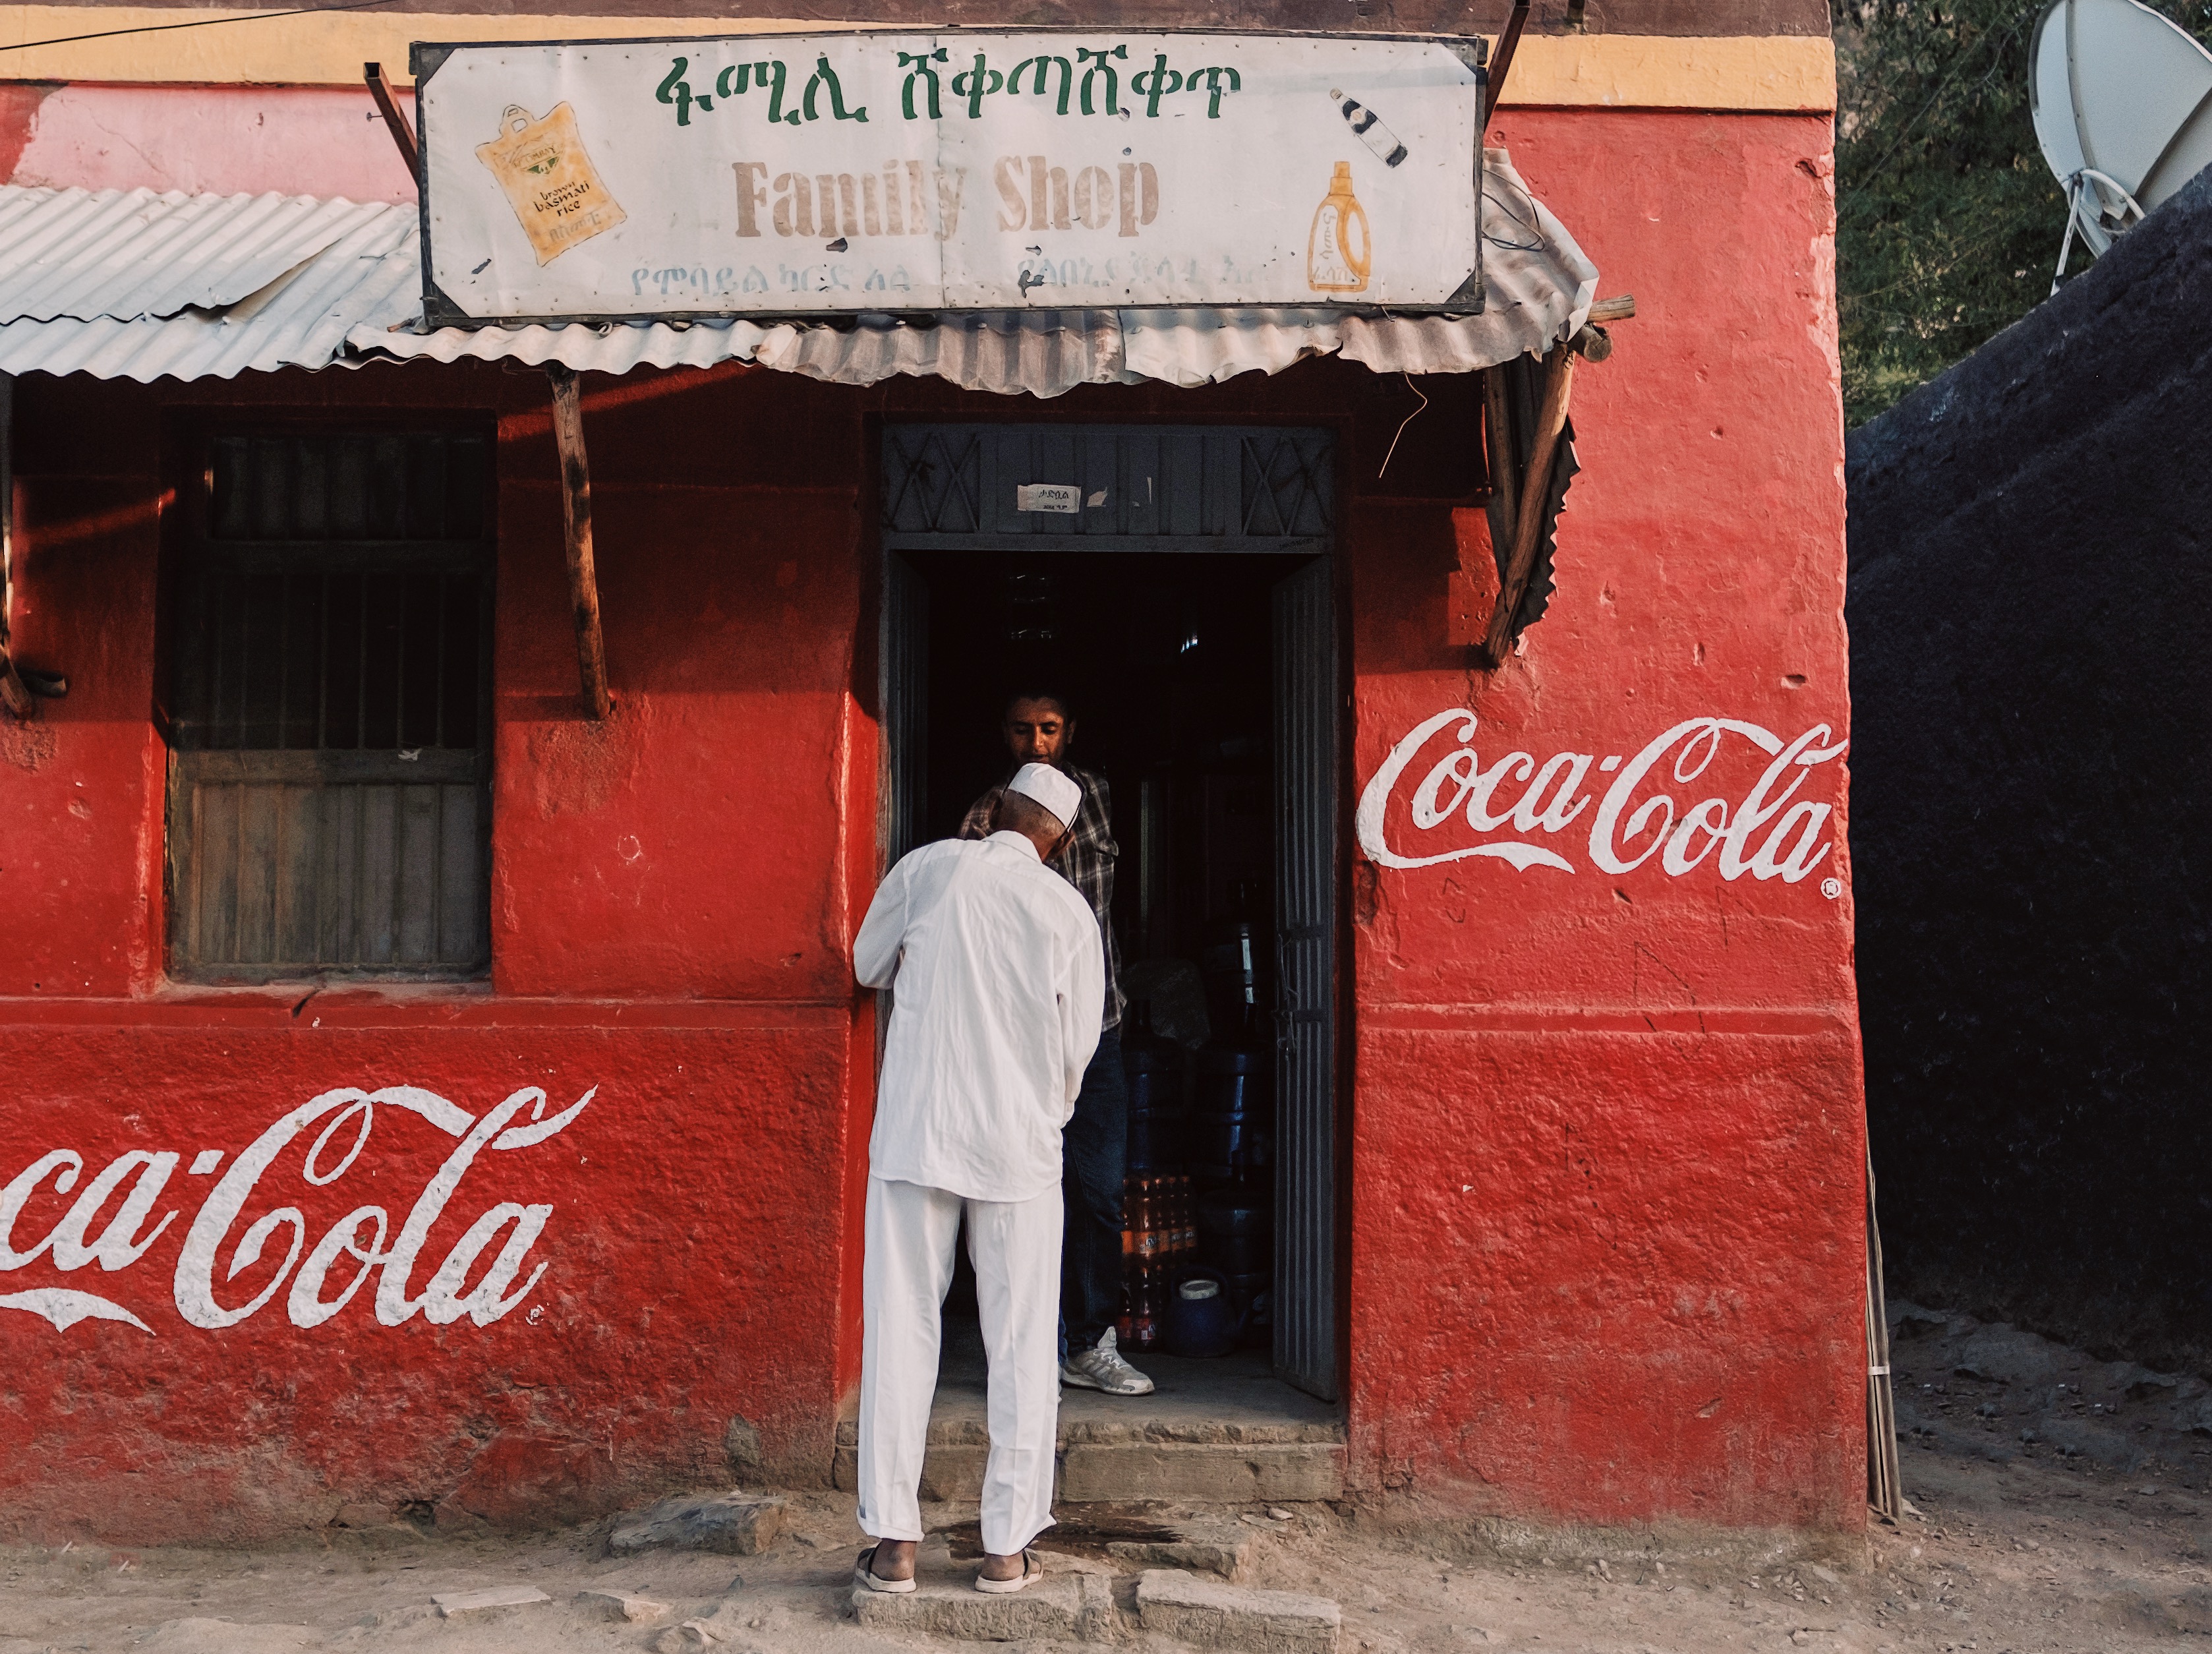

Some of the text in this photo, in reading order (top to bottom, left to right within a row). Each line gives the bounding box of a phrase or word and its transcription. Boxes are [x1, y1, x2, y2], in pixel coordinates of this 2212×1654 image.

[656, 44, 1241, 127] ፋሚሊ ሸቀጣሸቀጥ
[540, 181, 575, 200] brown
[556, 200, 581, 217] rice
[732, 155, 1159, 241] Family Shop
[1355, 708, 1848, 883] Coca-Cola
[0, 1082, 598, 1336] ca-Cola
